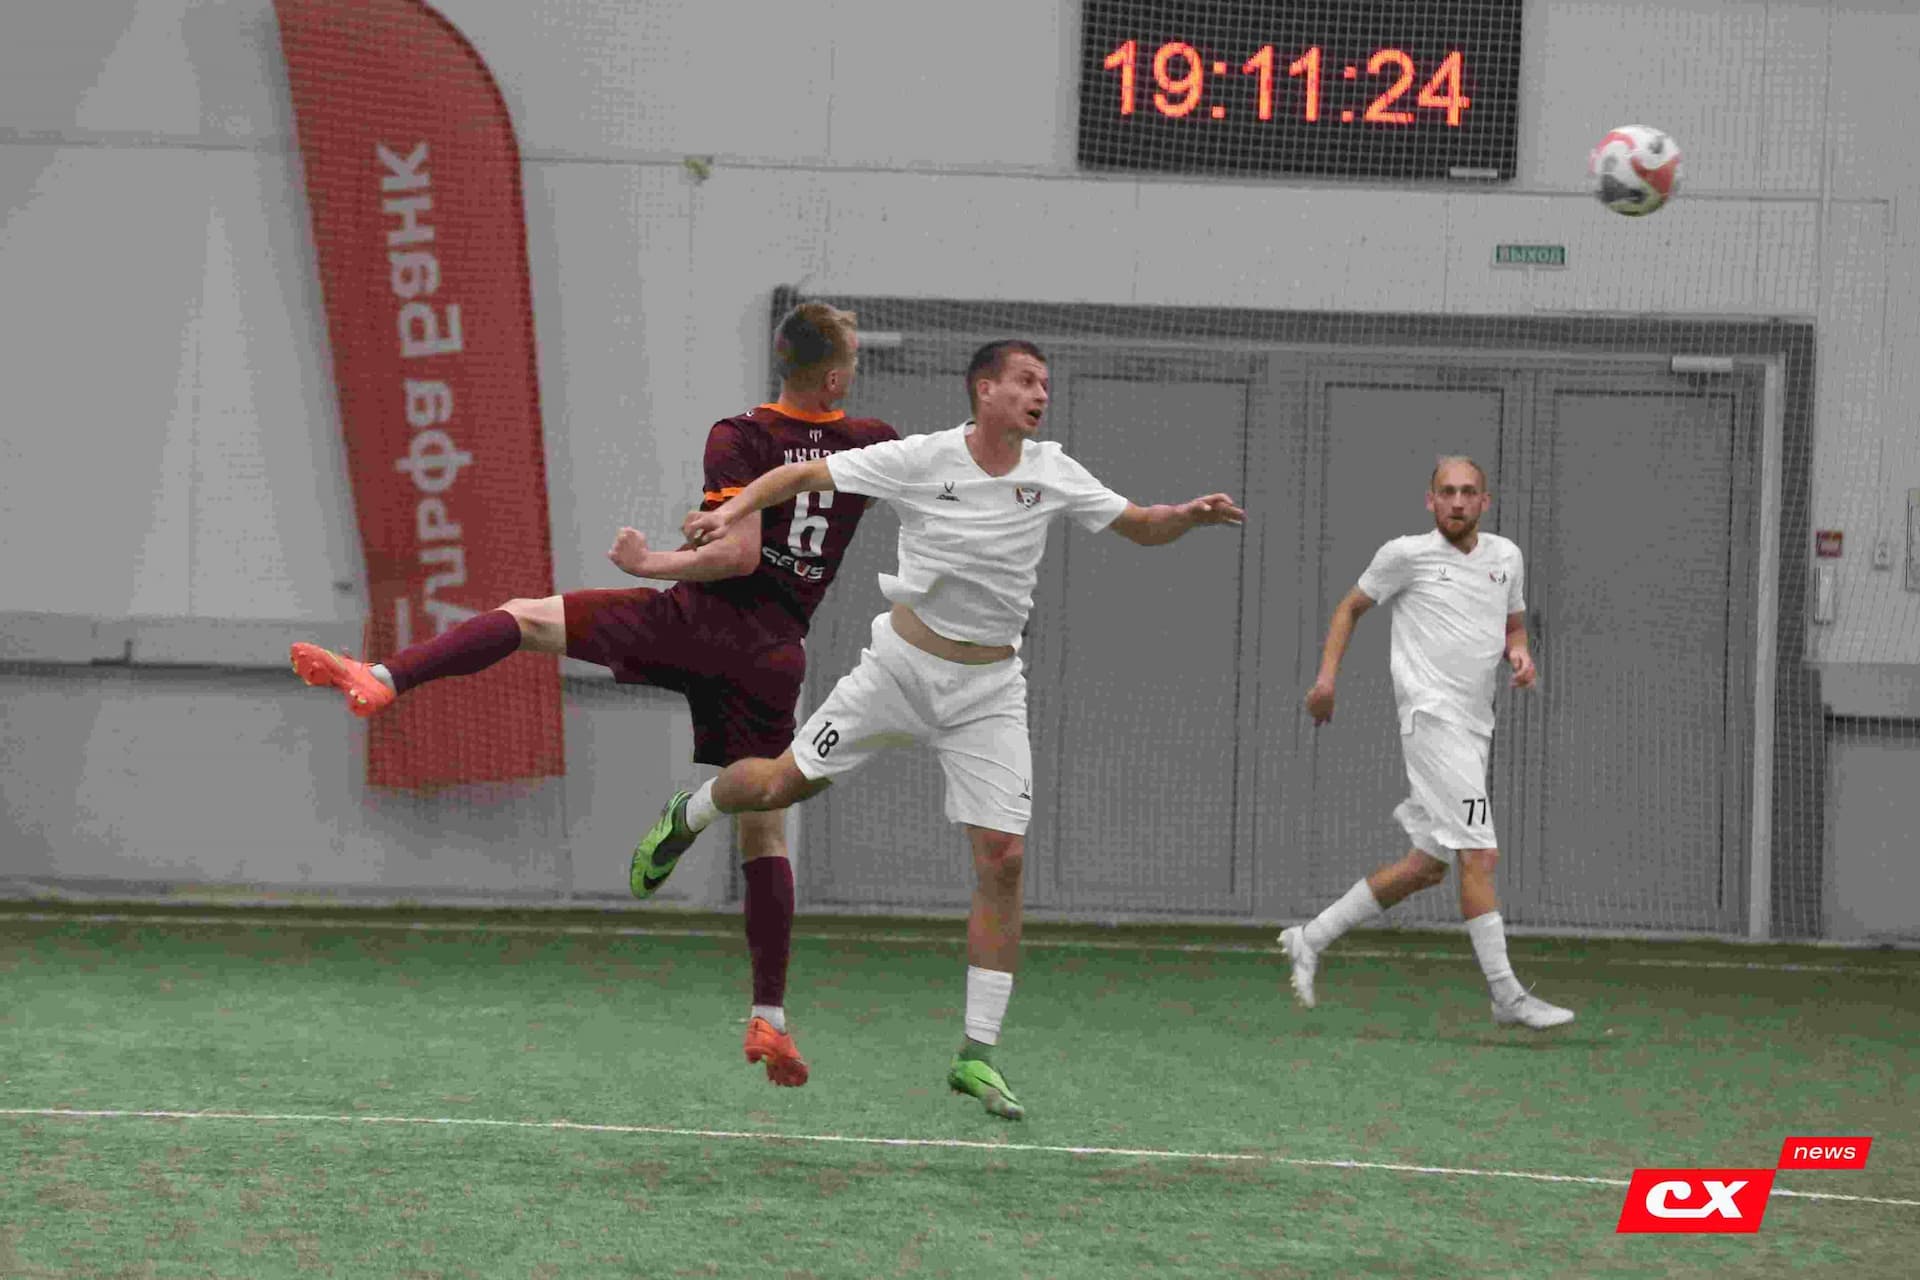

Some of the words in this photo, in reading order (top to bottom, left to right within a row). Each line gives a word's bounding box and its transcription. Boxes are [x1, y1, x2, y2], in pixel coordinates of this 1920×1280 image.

[1104, 40, 1471, 126] 19:11:24
[787, 490, 834, 557] 6
[812, 721, 840, 758] 18
[1462, 798, 1486, 826] 77
